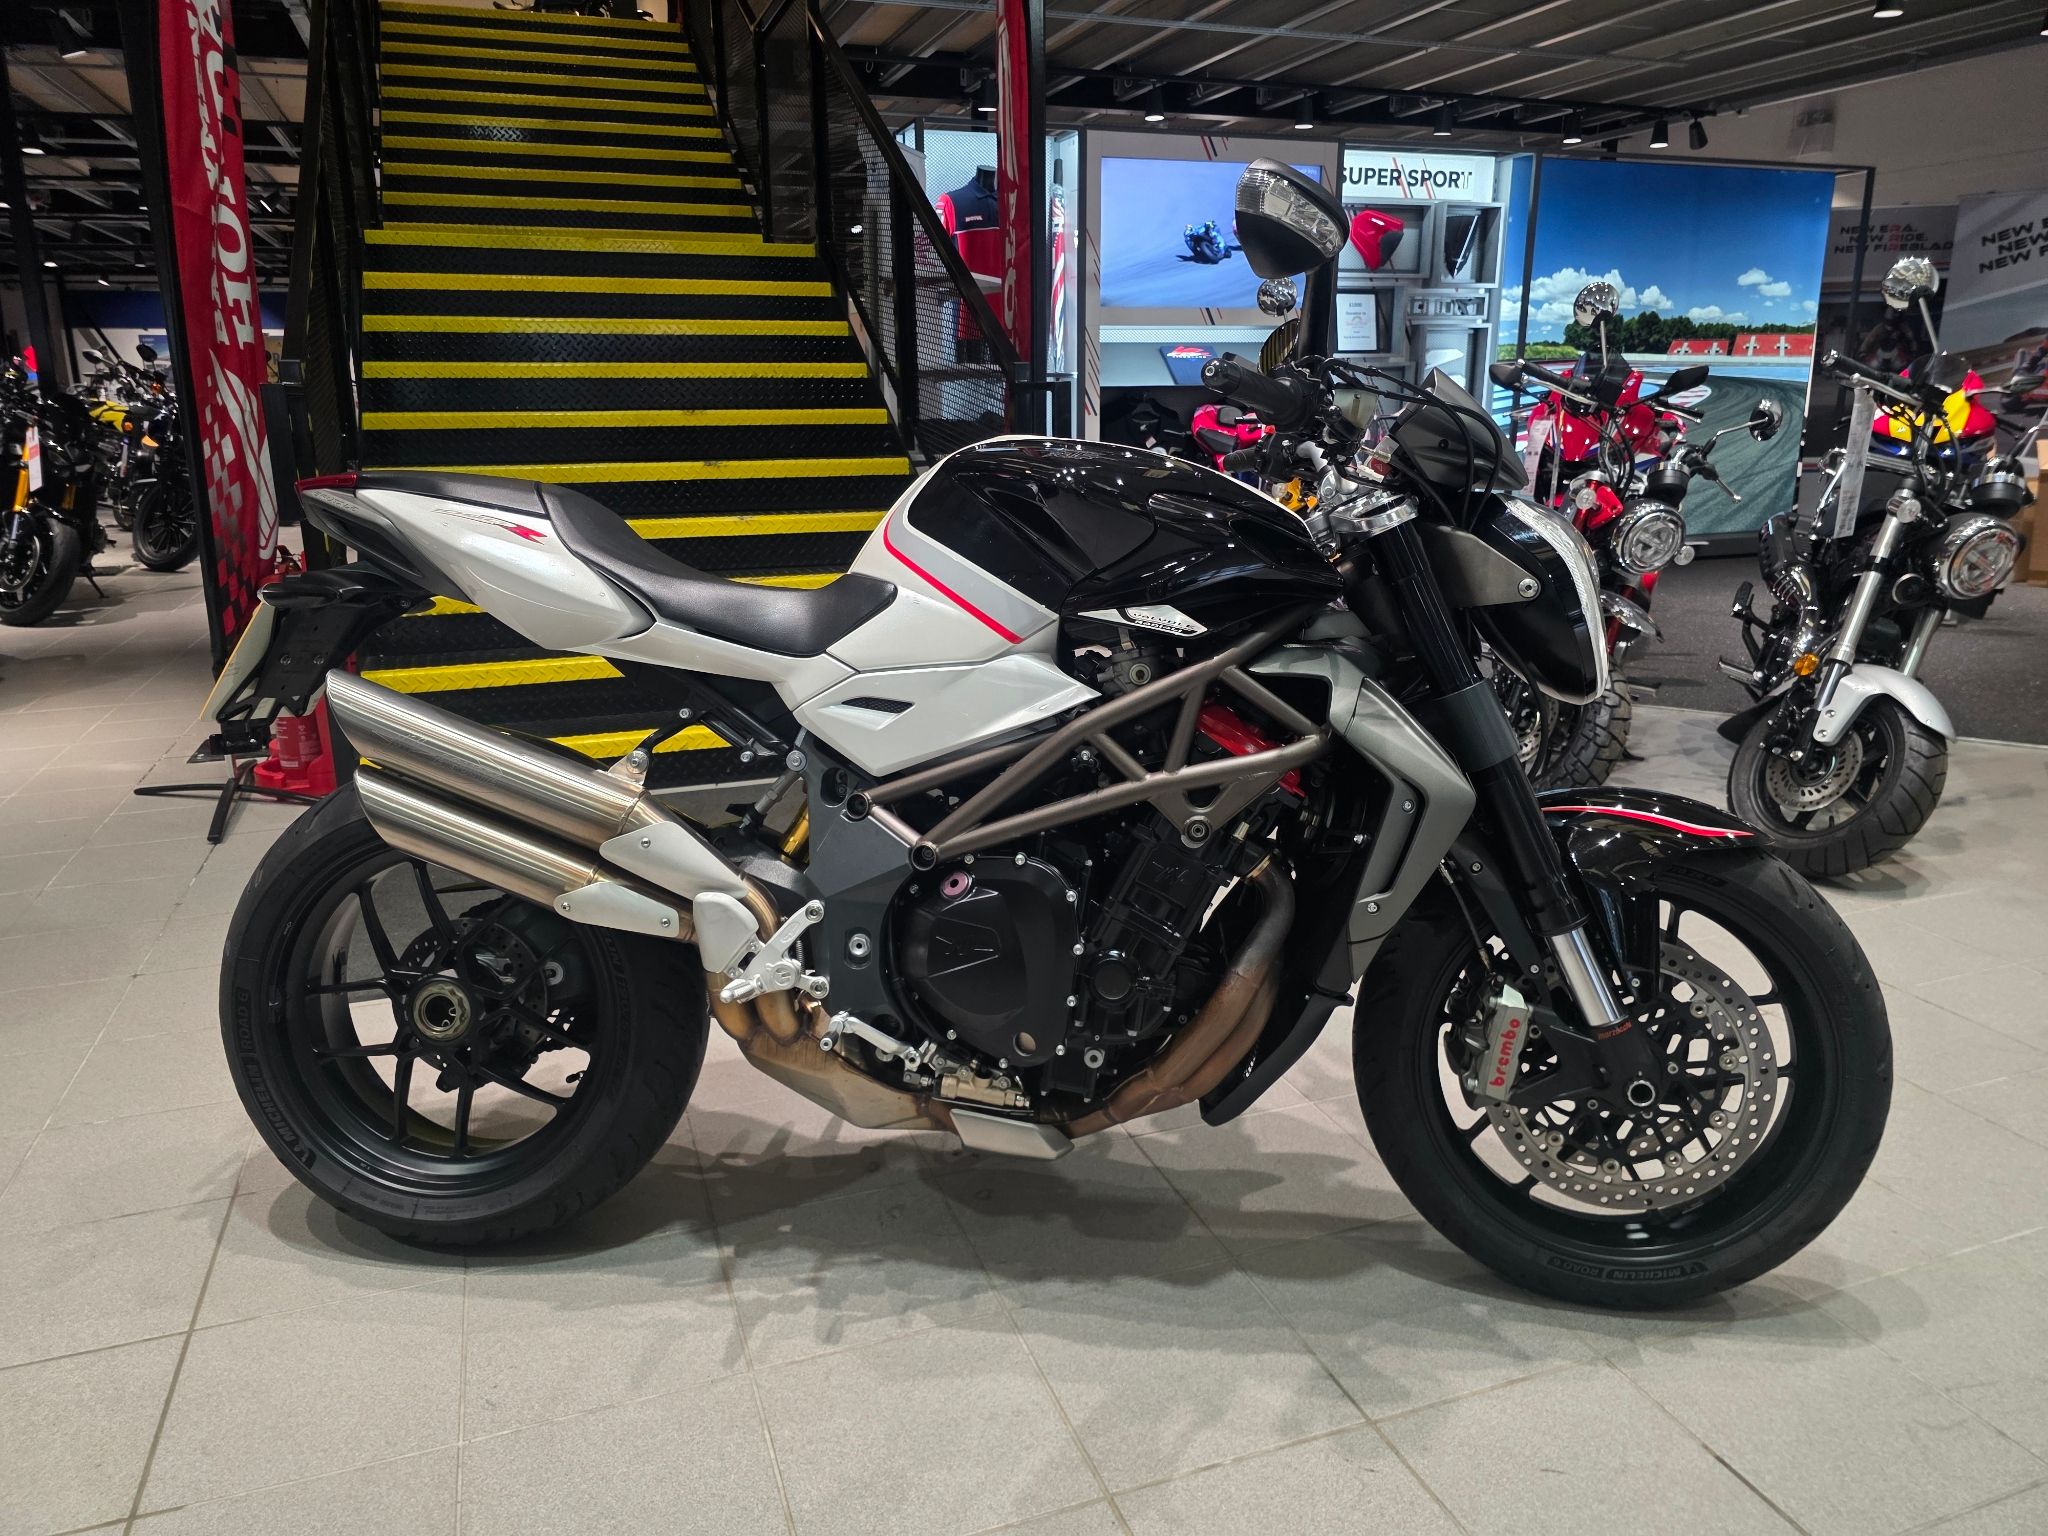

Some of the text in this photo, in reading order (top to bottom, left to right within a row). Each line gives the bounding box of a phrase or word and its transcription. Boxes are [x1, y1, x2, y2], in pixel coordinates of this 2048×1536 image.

[186, 0, 232, 346] BALLYMEN
[1407, 169, 1473, 190] SPORT
[1849, 235, 1883, 244] NW
[1981, 222, 2034, 247] NEW
[1998, 229, 2048, 255] NEW
[1979, 249, 2032, 274] NEW
[237, 1005, 253, 1051] ROAD
[1489, 1018, 1521, 1087] brembo
[245, 1063, 297, 1143] MICHELIN
[1563, 1261, 1600, 1276] ROAD
[1613, 1265, 1682, 1280] MICHELIN
